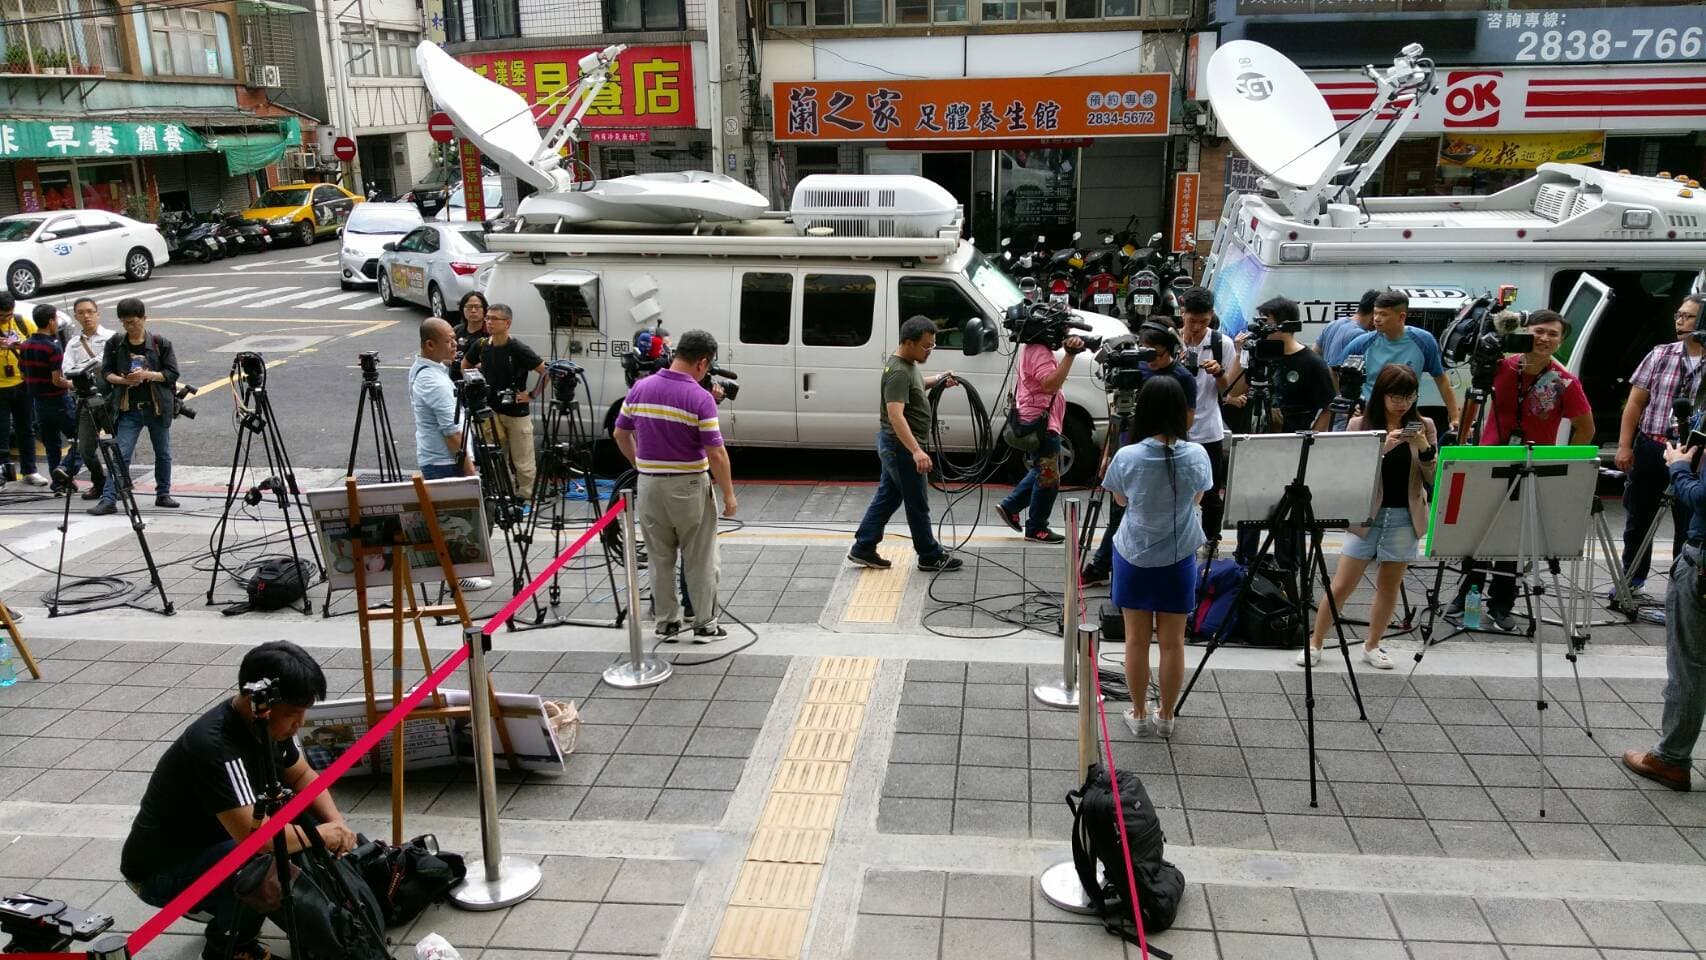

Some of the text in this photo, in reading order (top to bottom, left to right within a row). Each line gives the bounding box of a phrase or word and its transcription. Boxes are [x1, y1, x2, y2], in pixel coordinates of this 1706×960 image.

[1515, 27, 1706, 61] 2838-766
[533, 59, 680, 116] 早餐店
[1088, 91, 1157, 108] 預約專線
[1446, 80, 1500, 116] OK
[788, 87, 1061, 136] 蘭之家 足體養生館
[1087, 111, 1155, 126] 2834-5672
[47, 125, 118, 154] 早餐
